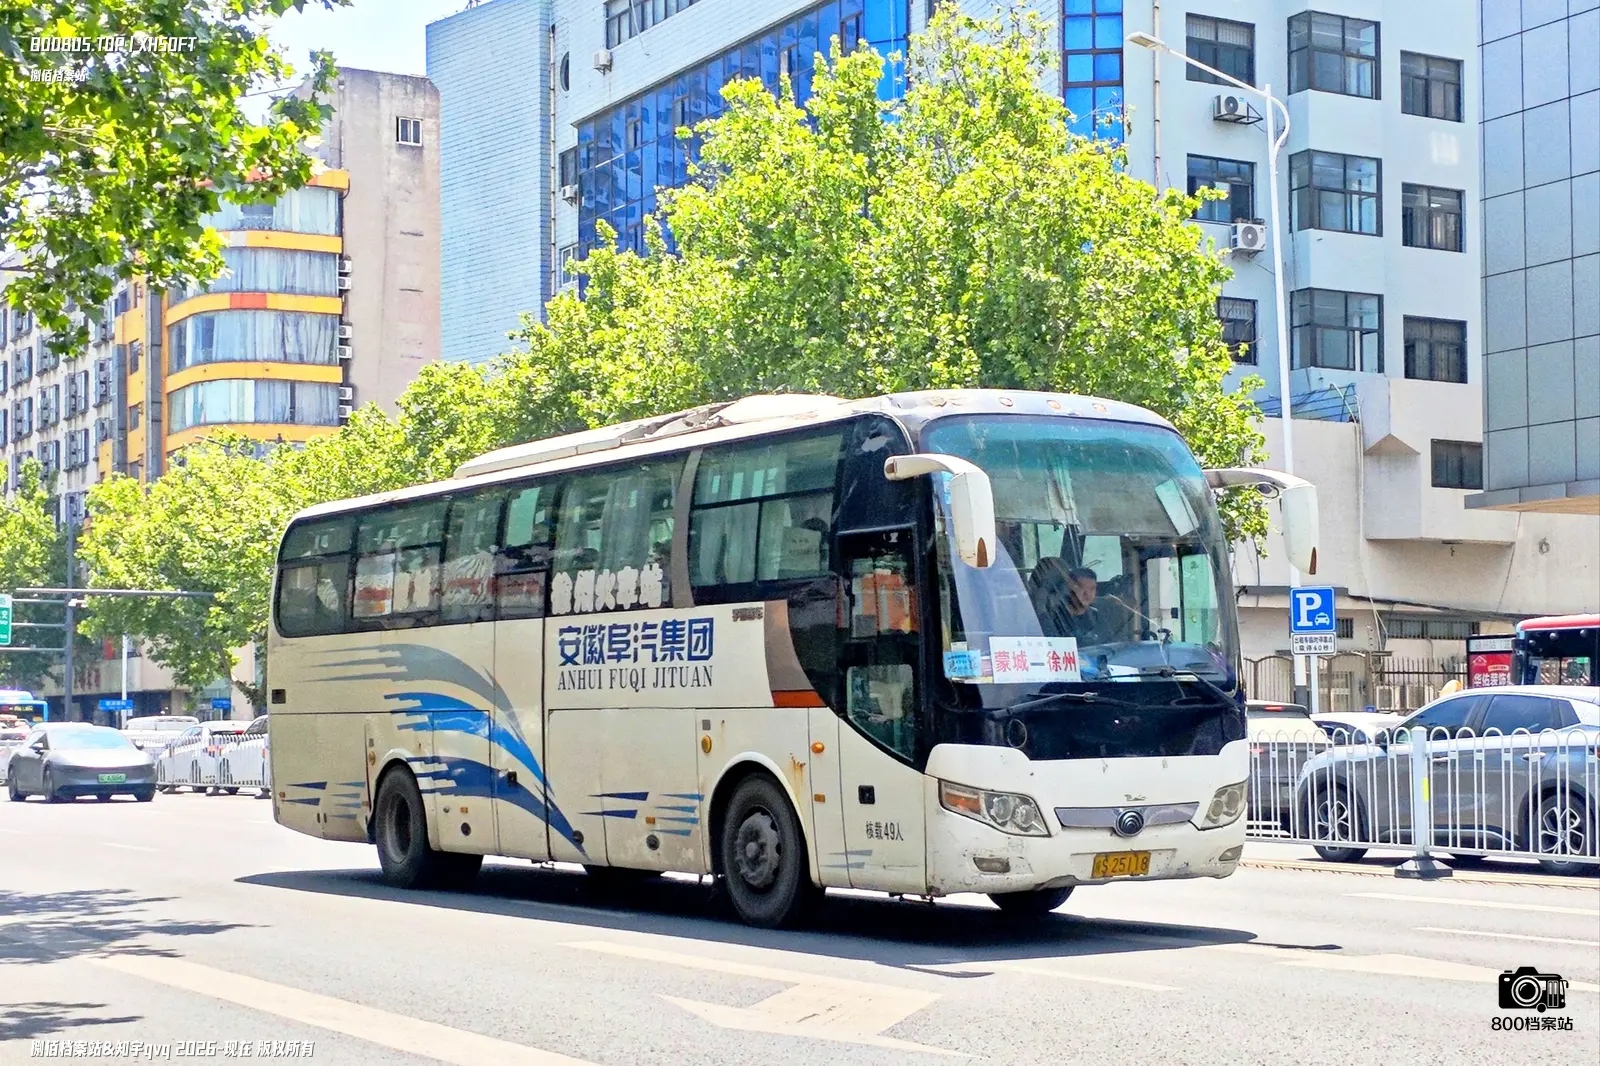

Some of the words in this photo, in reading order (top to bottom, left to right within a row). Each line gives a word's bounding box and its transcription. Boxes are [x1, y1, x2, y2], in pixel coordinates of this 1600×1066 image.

[1295, 592, 1322, 627] P
[558, 617, 714, 667] 安徽阜汽集团
[557, 668, 603, 691] ANHUI
[609, 667, 646, 692] FUQI
[652, 665, 713, 689] JITUAN
[866, 821, 904, 841] 核载49人
[1095, 855, 1148, 874] S·25118
